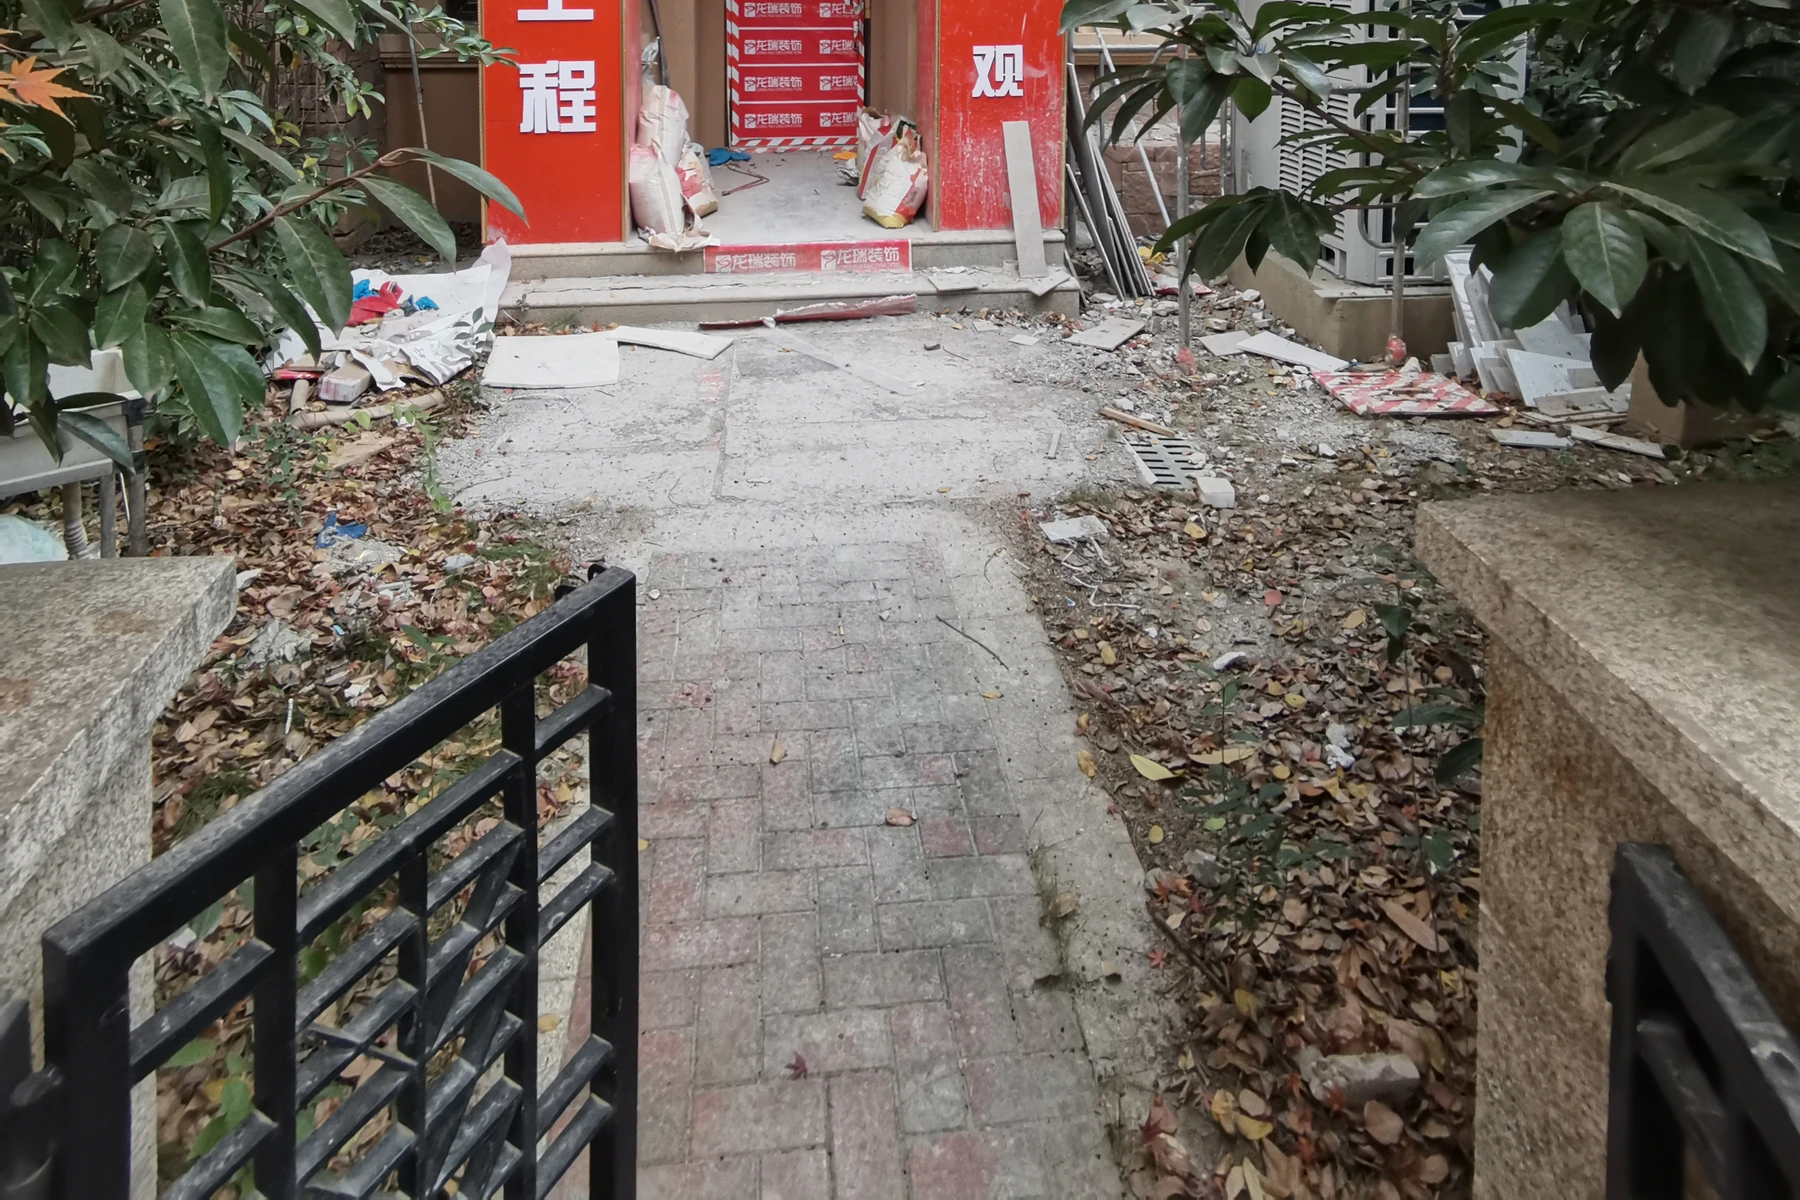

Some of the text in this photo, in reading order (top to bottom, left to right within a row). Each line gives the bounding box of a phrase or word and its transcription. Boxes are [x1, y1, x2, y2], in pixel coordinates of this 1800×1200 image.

[756, 2, 802, 14] 龙瑞装饰
[756, 40, 802, 51] 龙瑞装饰
[831, 40, 855, 51] 龙瑞
[756, 76, 803, 88] 龙瑞装饰
[756, 113, 803, 125] 龙瑞装饰
[731, 252, 797, 270] 龙瑞装饰
[837, 246, 900, 265] 龙瑞装饰
